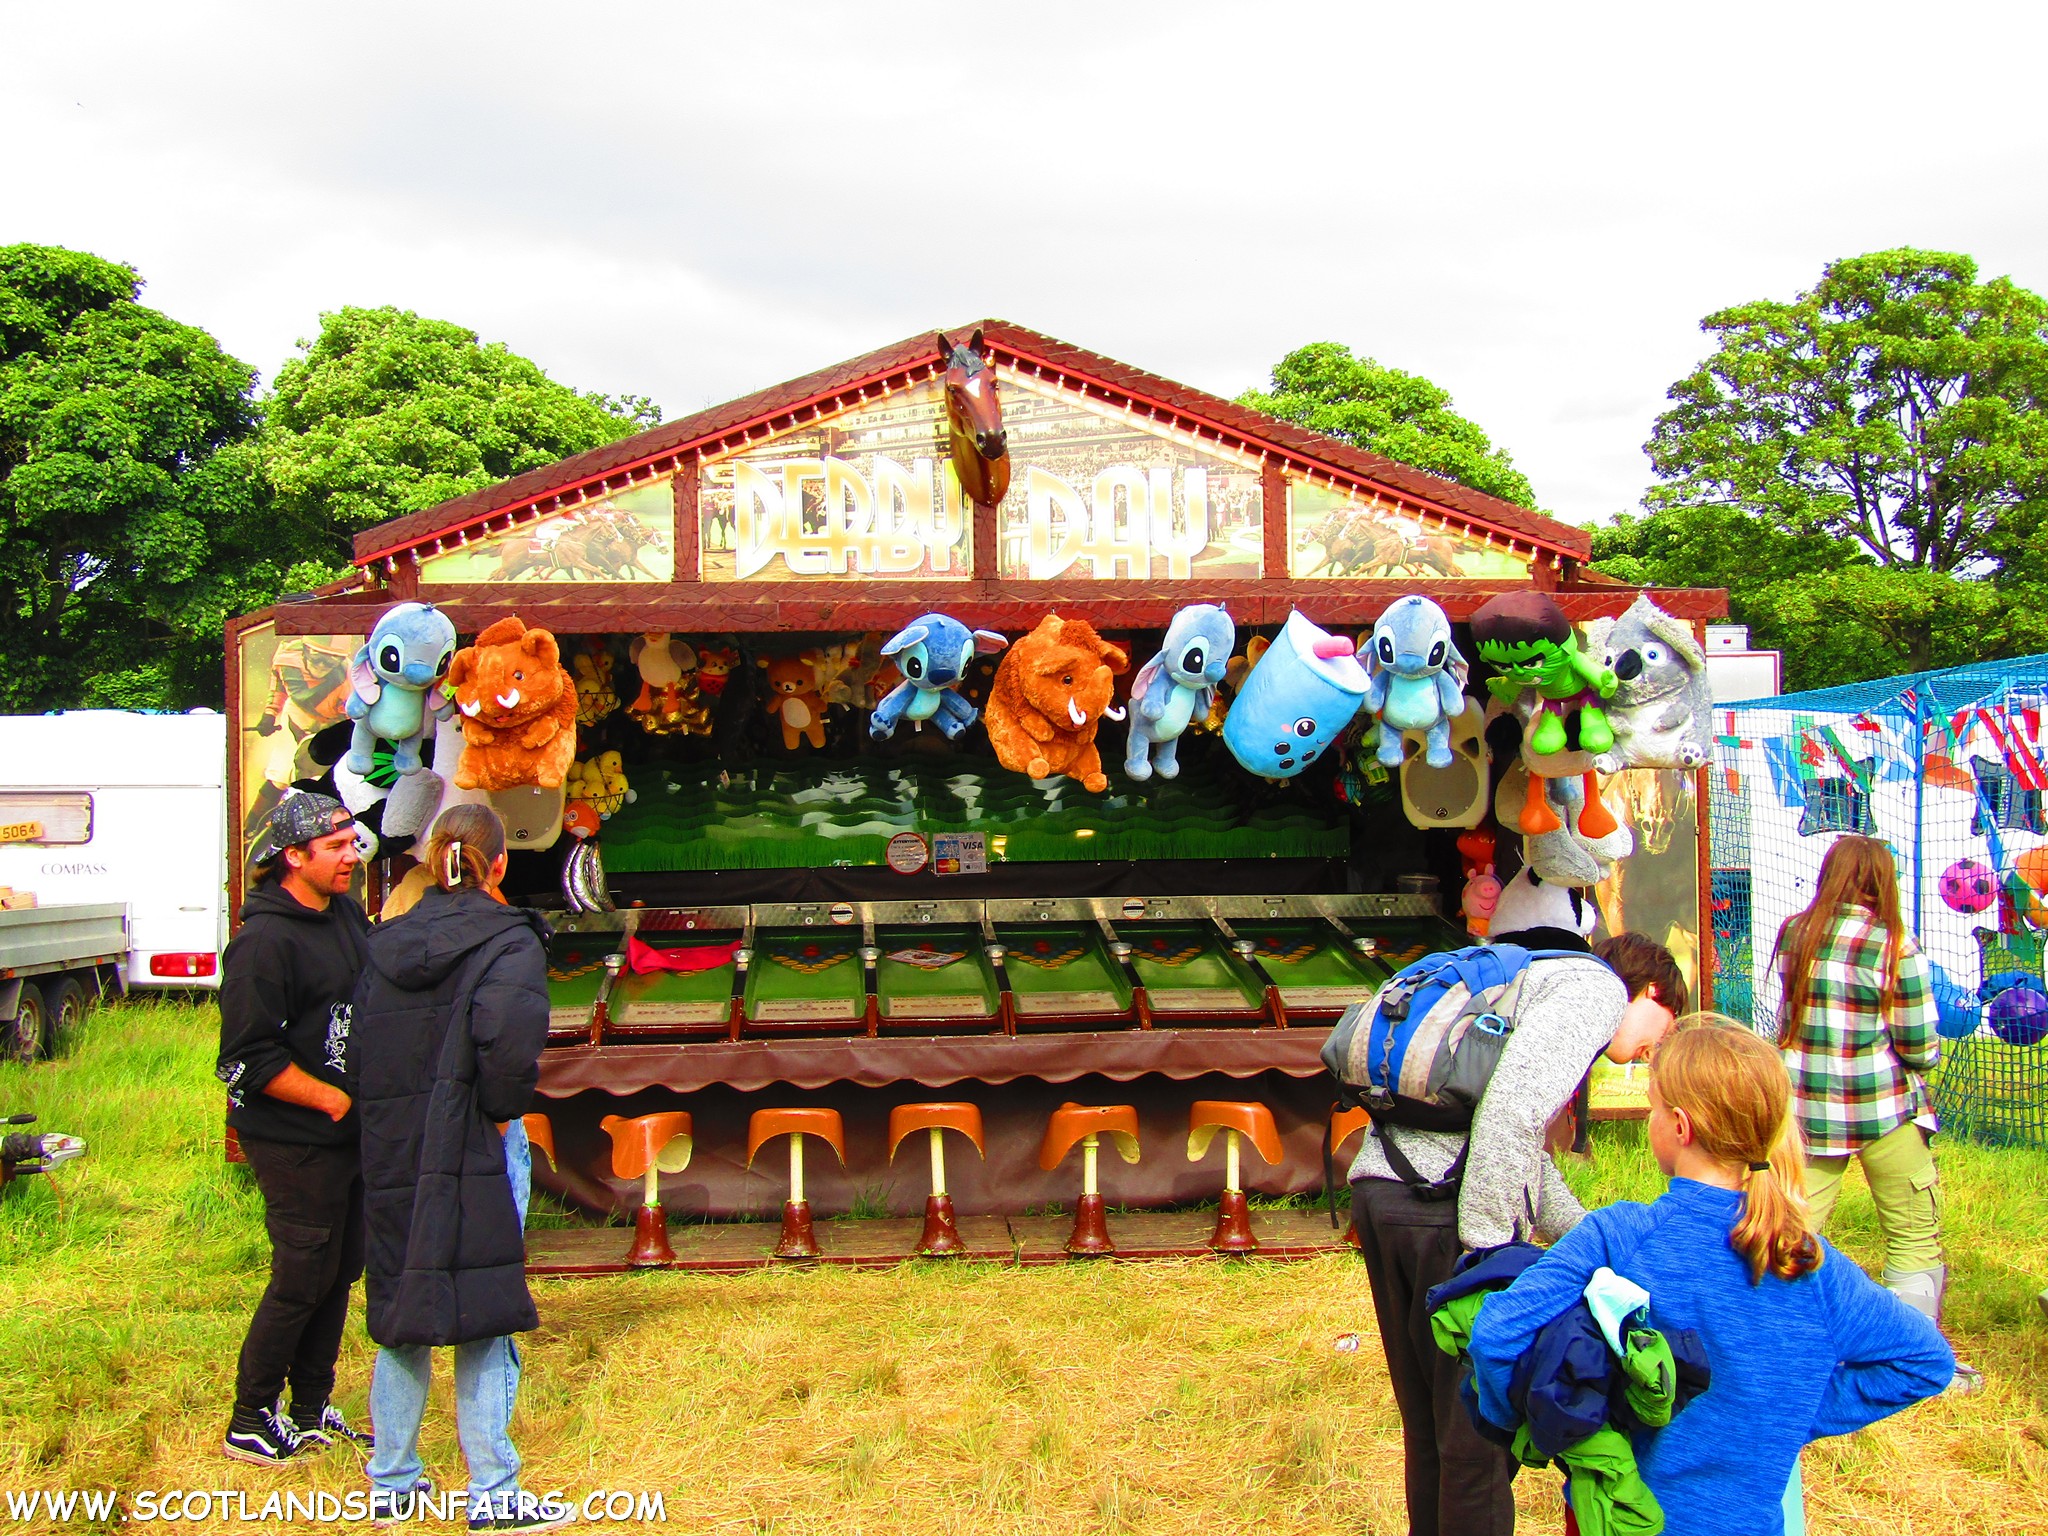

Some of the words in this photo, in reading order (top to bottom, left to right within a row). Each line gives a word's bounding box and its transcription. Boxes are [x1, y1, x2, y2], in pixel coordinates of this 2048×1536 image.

[735, 456, 963, 579] DERBY
[1028, 465, 1207, 580] DAY
[2, 824, 37, 839] 5064
[961, 841, 984, 849] VISA
[41, 863, 107, 875] COMPASS
